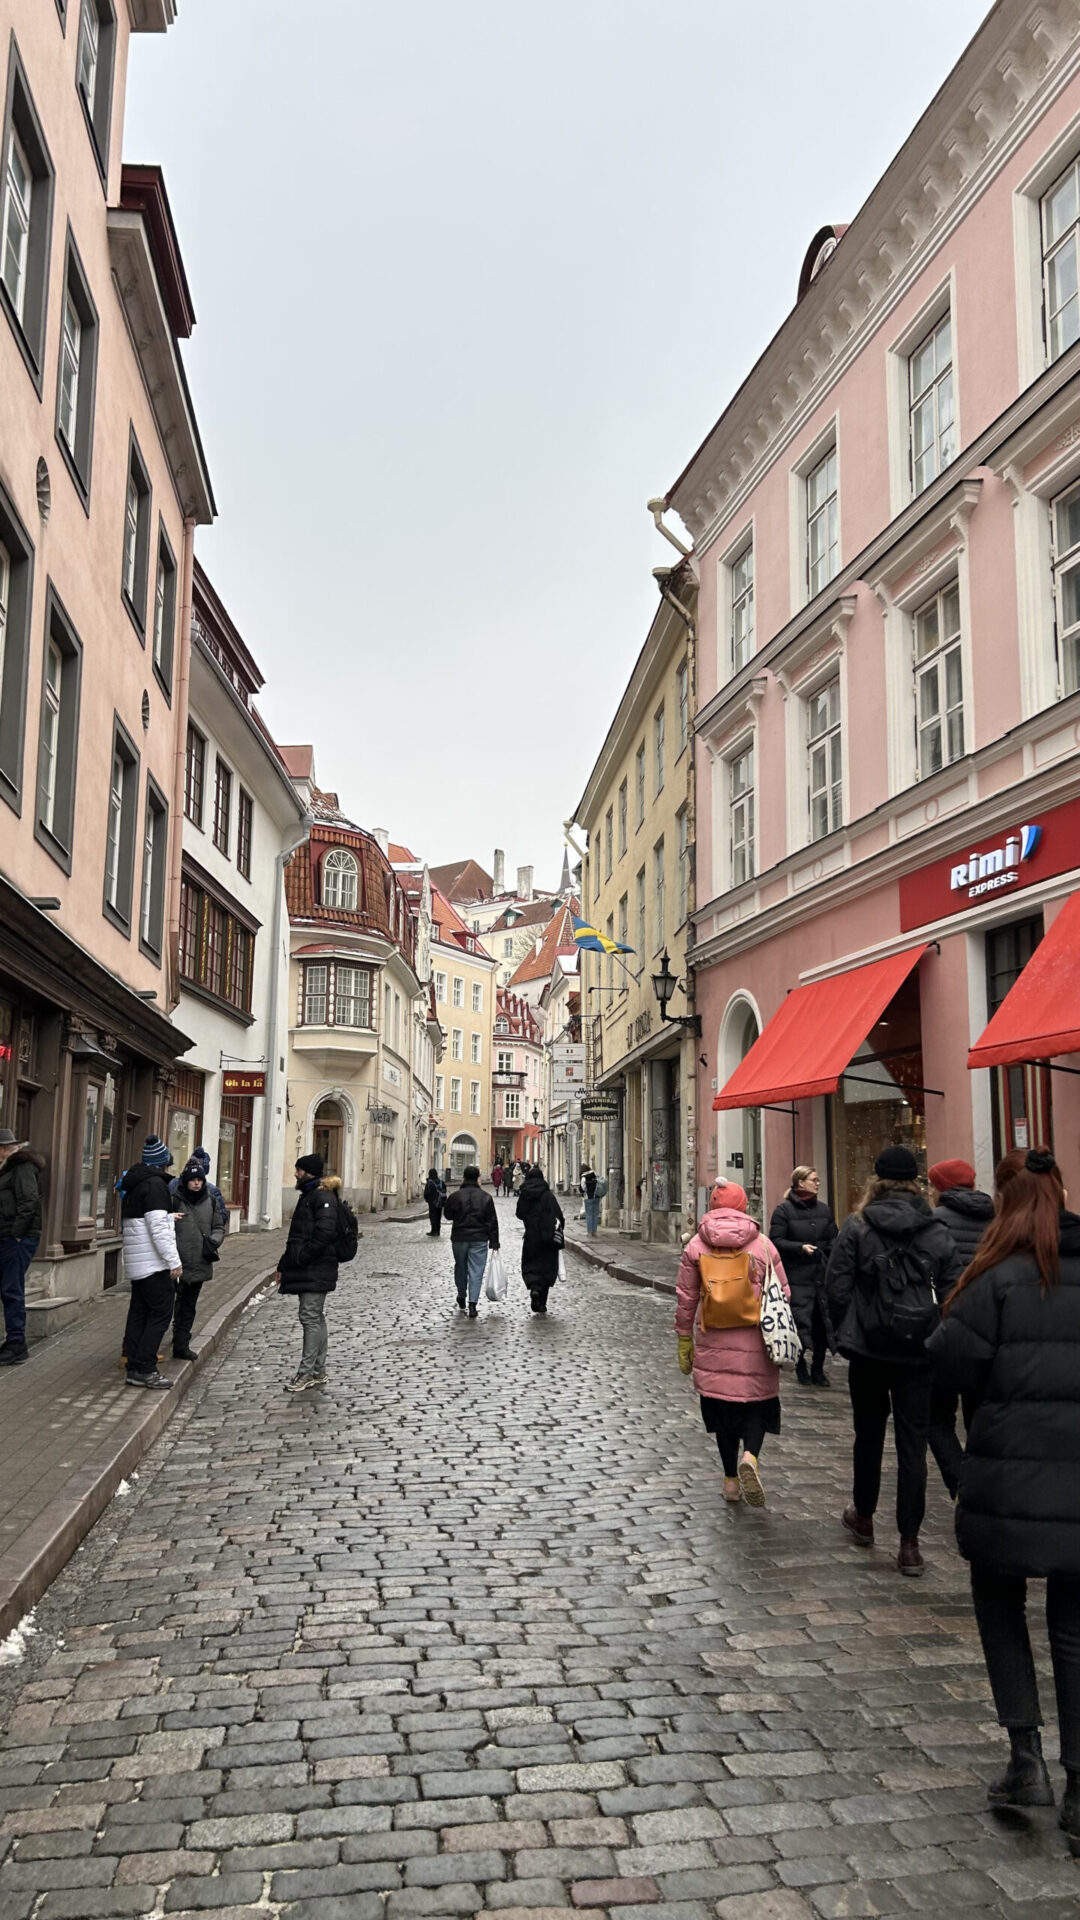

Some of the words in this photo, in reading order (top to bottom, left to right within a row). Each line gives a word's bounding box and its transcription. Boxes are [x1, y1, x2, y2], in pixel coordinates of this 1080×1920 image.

[950, 836, 1020, 890] Rimi
[968, 872, 1018, 898] EXPRESS
[225, 1079, 239, 1087] Oh
[241, 1079, 251, 1087] la
[371, 1111, 391, 1122] VeTa
